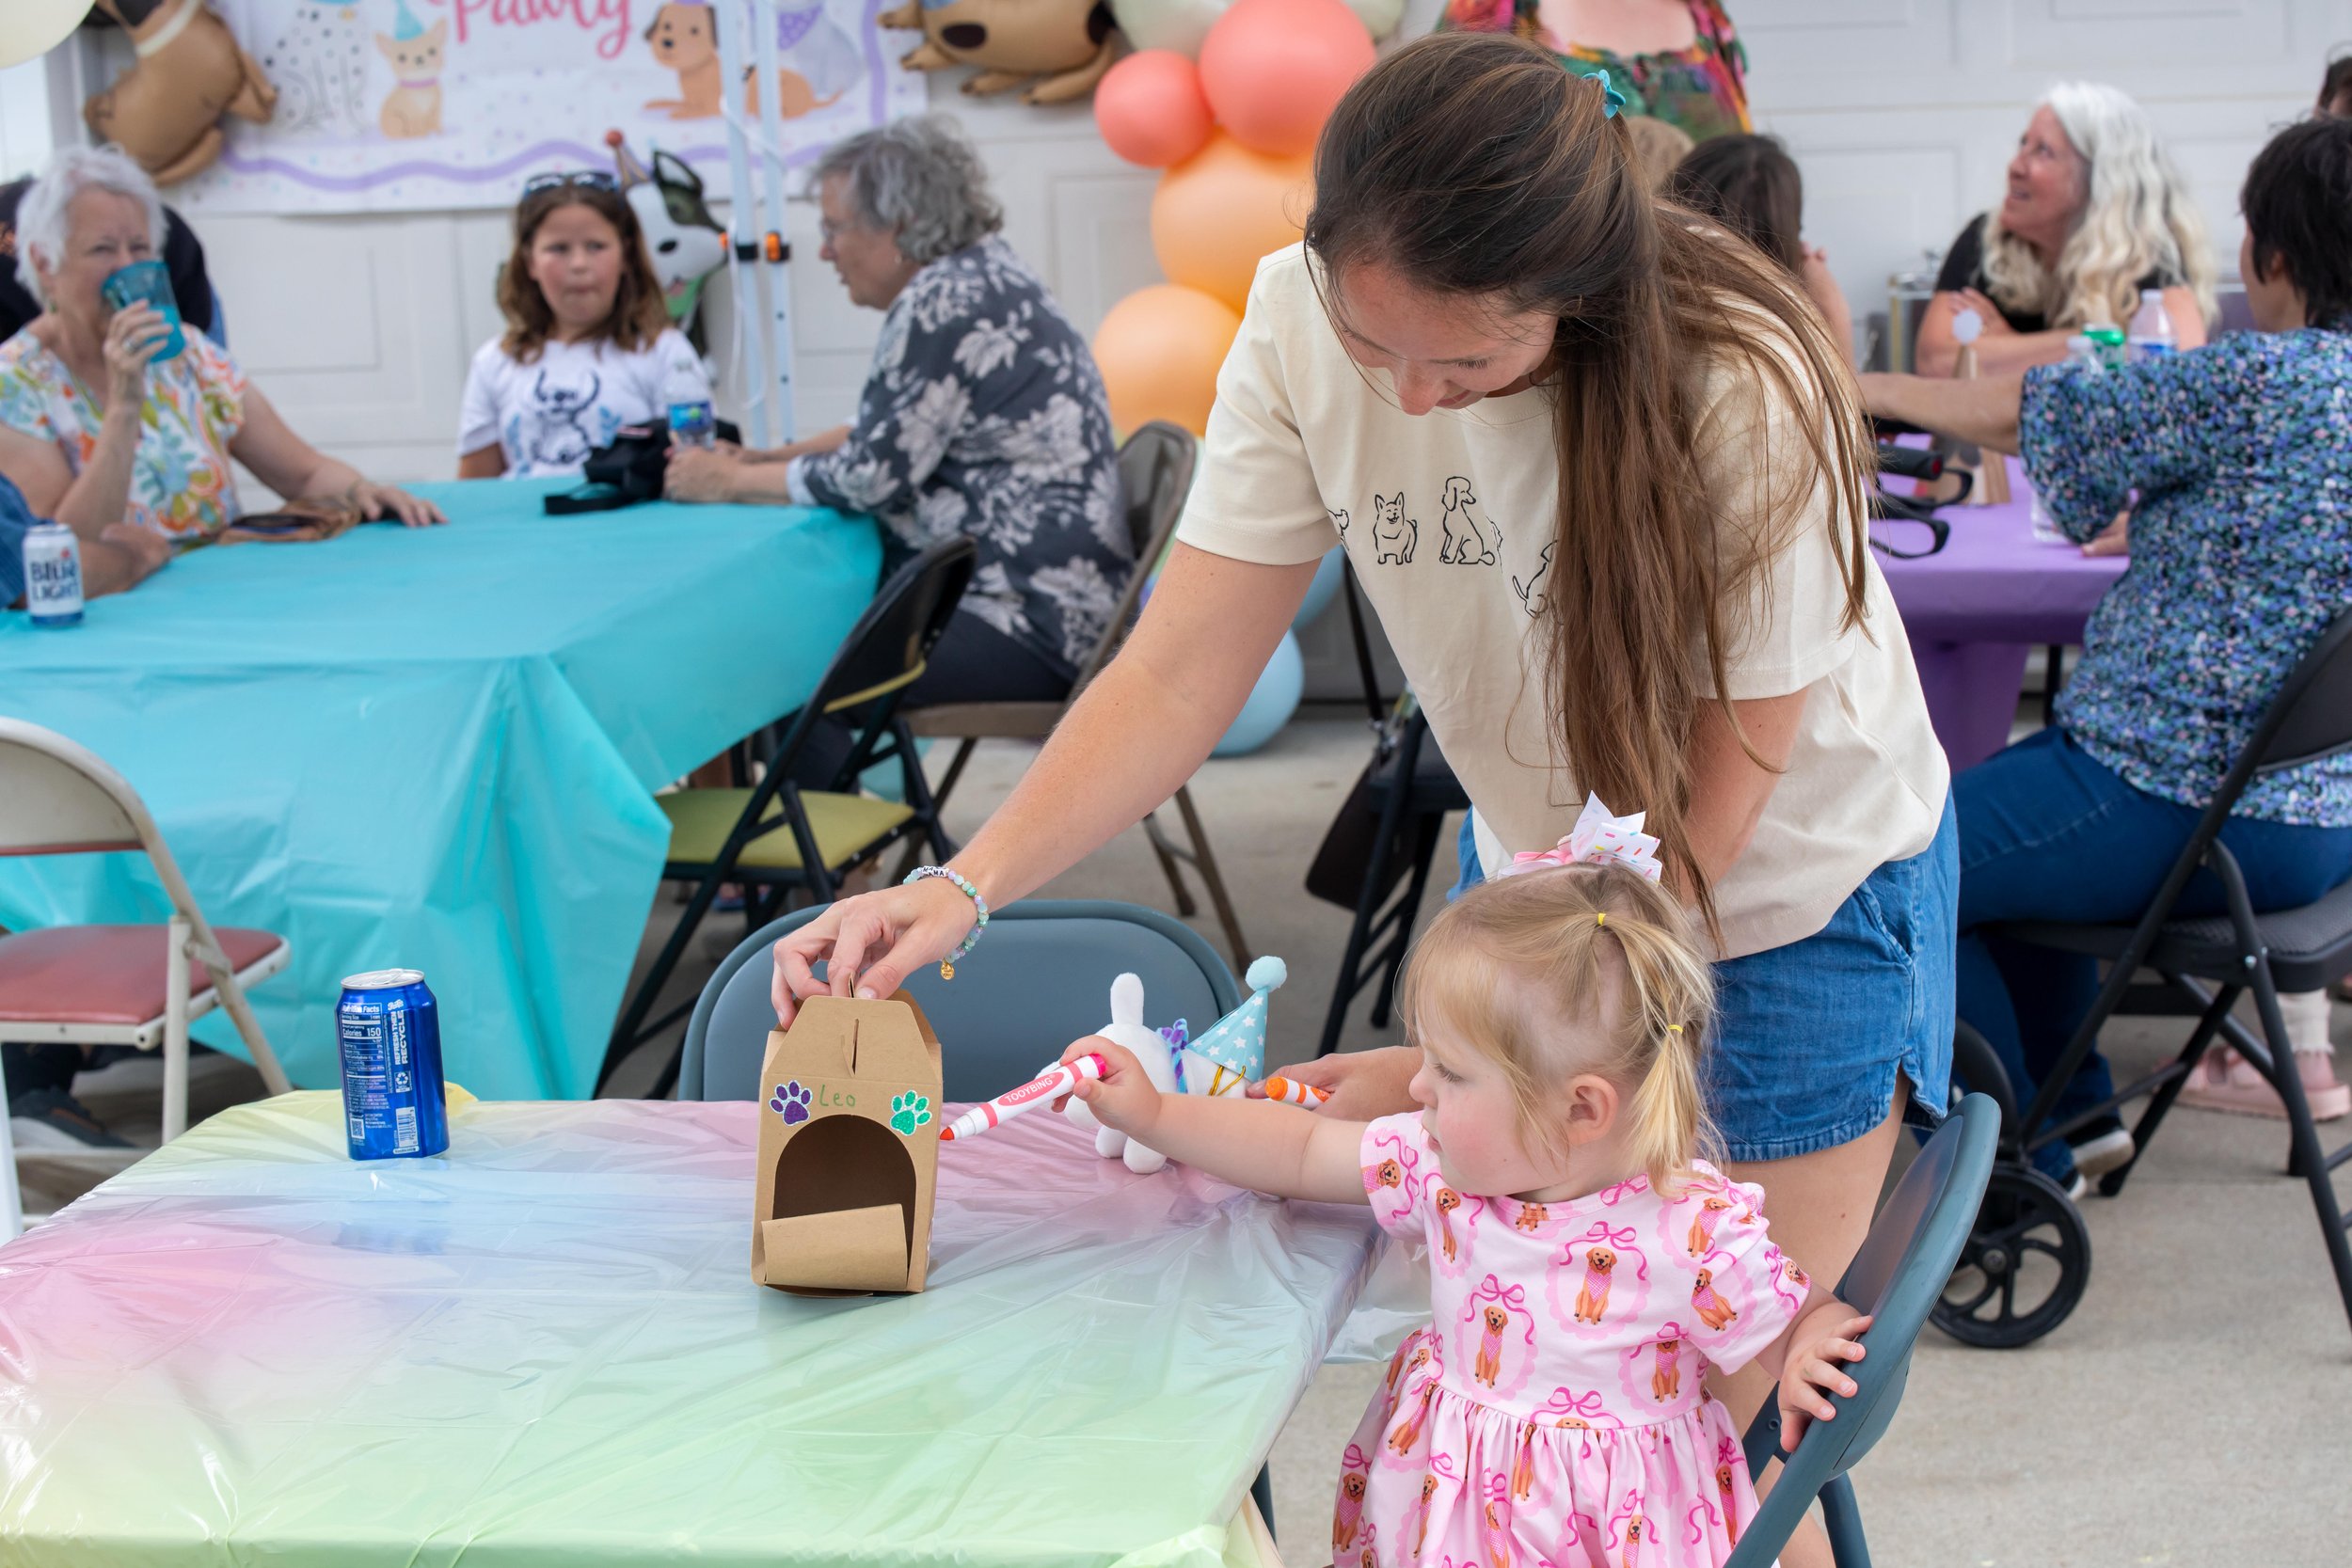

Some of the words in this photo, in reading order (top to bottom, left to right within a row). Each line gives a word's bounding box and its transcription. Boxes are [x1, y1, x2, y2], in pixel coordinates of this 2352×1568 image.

[342, 1028, 362, 1037] Calories
[367, 1027, 381, 1037] 150
[397, 1010, 408, 1065] RECYCLE
[819, 1084, 856, 1107] Leo
